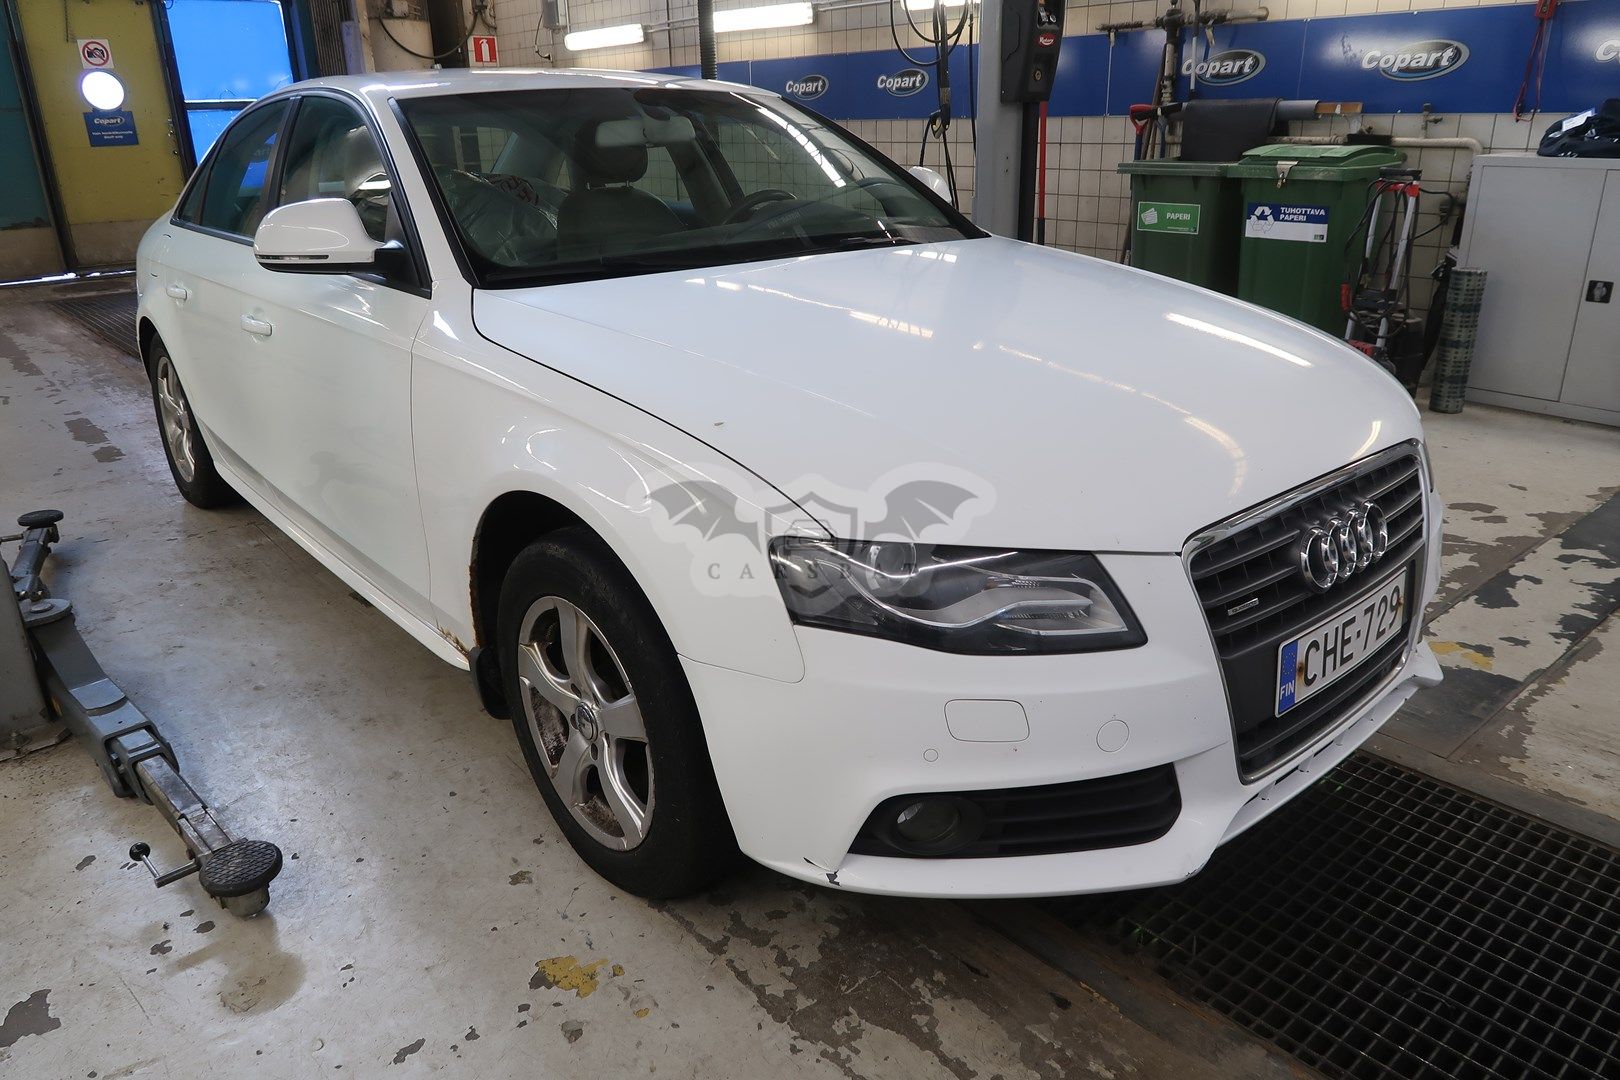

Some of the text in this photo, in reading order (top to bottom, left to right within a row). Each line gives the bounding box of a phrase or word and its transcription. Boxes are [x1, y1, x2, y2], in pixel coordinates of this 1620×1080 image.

[1181, 54, 1253, 77] Copart
[1361, 47, 1456, 72] Copart
[786, 79, 823, 94] Copart
[877, 73, 922, 91] Copart
[94, 117, 121, 125] Copart
[1166, 212, 1191, 220] PAPERI
[1280, 207, 1326, 215] TUHOTTAVA
[1304, 585, 1401, 687] CHE-729
[1280, 680, 1295, 700] FIN
